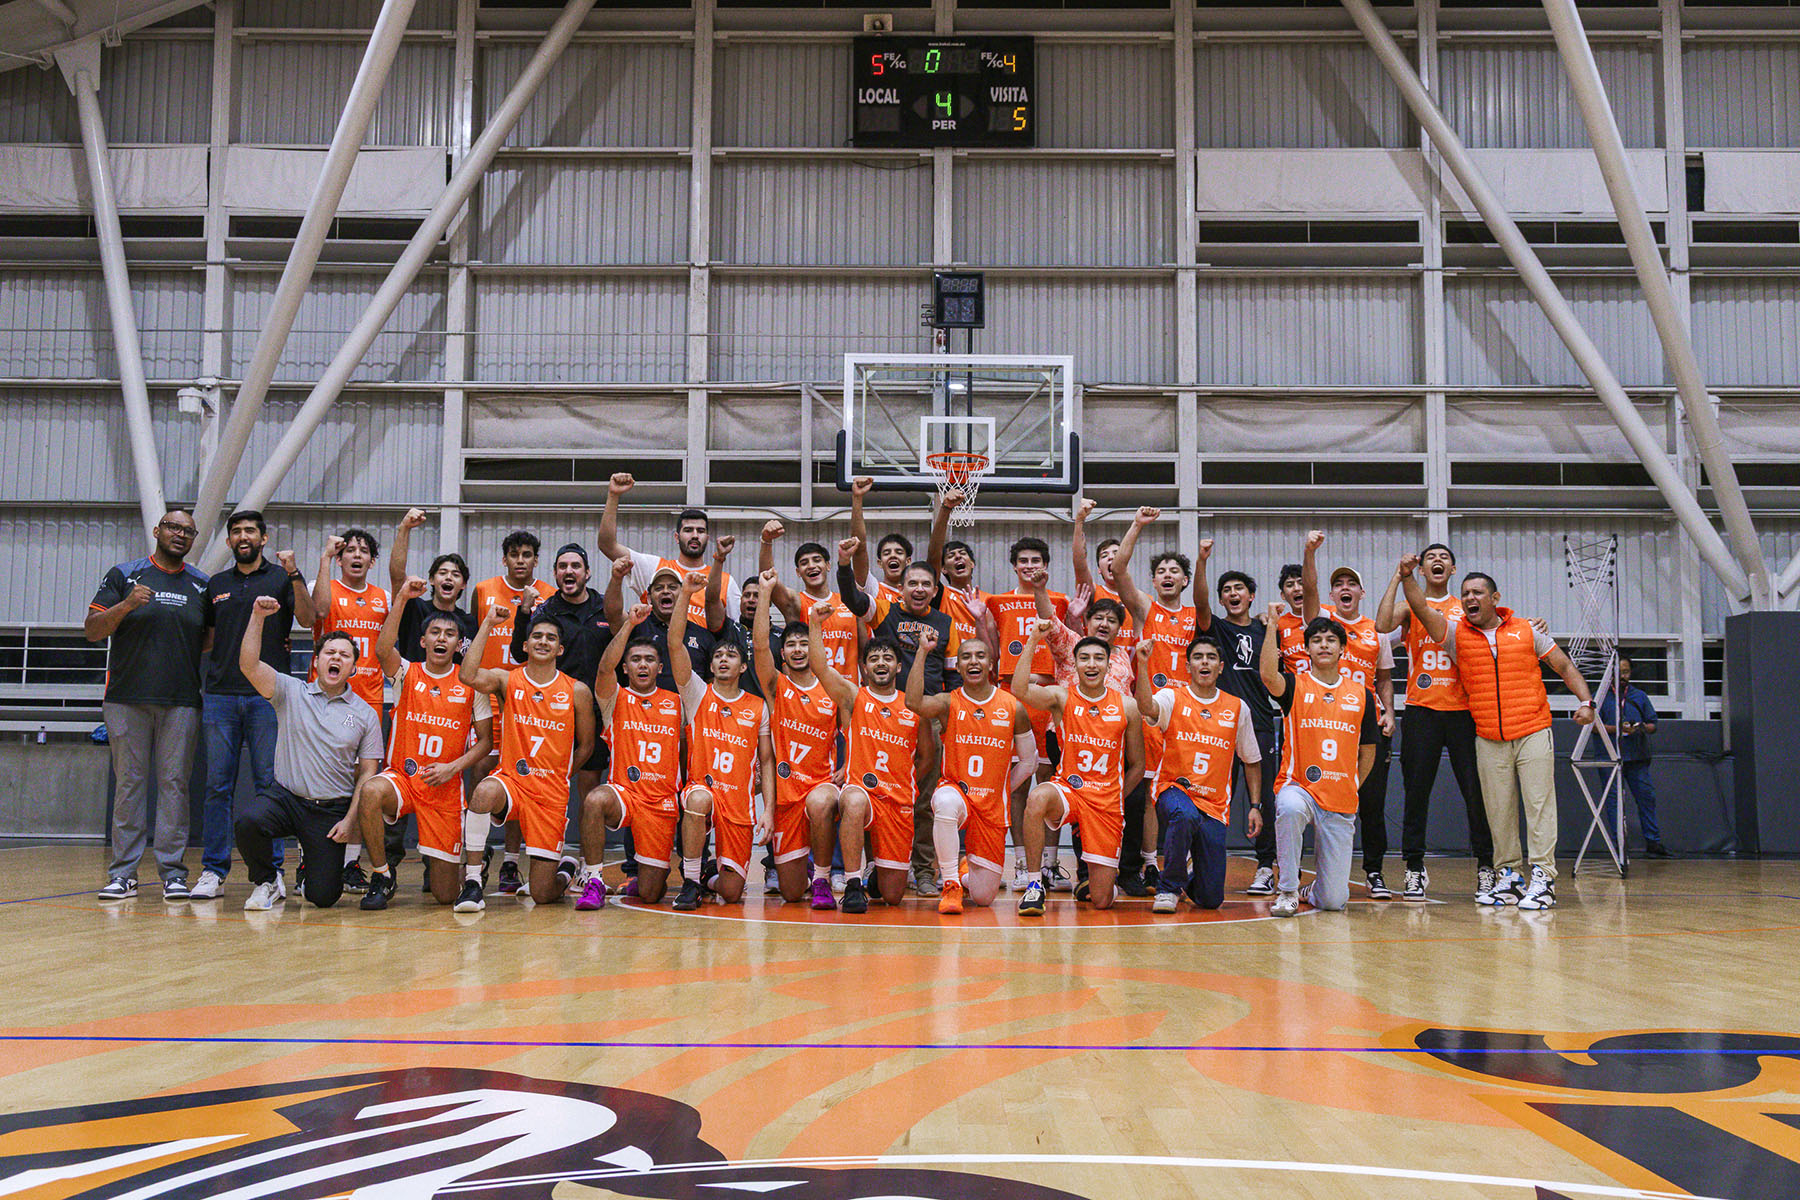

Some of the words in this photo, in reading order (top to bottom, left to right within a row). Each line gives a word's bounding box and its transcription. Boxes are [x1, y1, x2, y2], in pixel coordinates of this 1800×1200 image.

[872, 54, 884, 75] 5
[924, 49, 941, 73] 0
[1003, 55, 1016, 72] 4
[859, 88, 900, 104] LOCAL
[936, 93, 952, 116] 4
[990, 87, 1028, 102] VISITA
[932, 120, 957, 130] PER
[1013, 107, 1026, 131] 5
[155, 592, 188, 601] LEONES
[1016, 616, 1036, 636] 12
[824, 646, 845, 666] 24
[1170, 651, 1179, 671] 1
[1422, 650, 1452, 671] 95
[405, 711, 461, 730] ANÁHUAC
[513, 713, 566, 732] ANÁHUAC
[623, 720, 675, 736] ANÁHUAC
[779, 718, 828, 740] NÁHUAC
[1300, 716, 1356, 734] ANÁHUAC
[418, 733, 444, 758] 10
[529, 736, 545, 758] 7
[702, 727, 748, 748] ANÁHUAC
[1068, 733, 1118, 750] ANÁHUAC
[1176, 731, 1231, 750] ANÁHUAC
[637, 740, 662, 764] 13
[712, 747, 735, 774] 18
[789, 740, 812, 765] 17
[1321, 739, 1338, 761] 9
[875, 750, 890, 773] 2
[967, 755, 984, 778] 0
[1077, 750, 1110, 775] 34
[1192, 752, 1211, 775] 5
